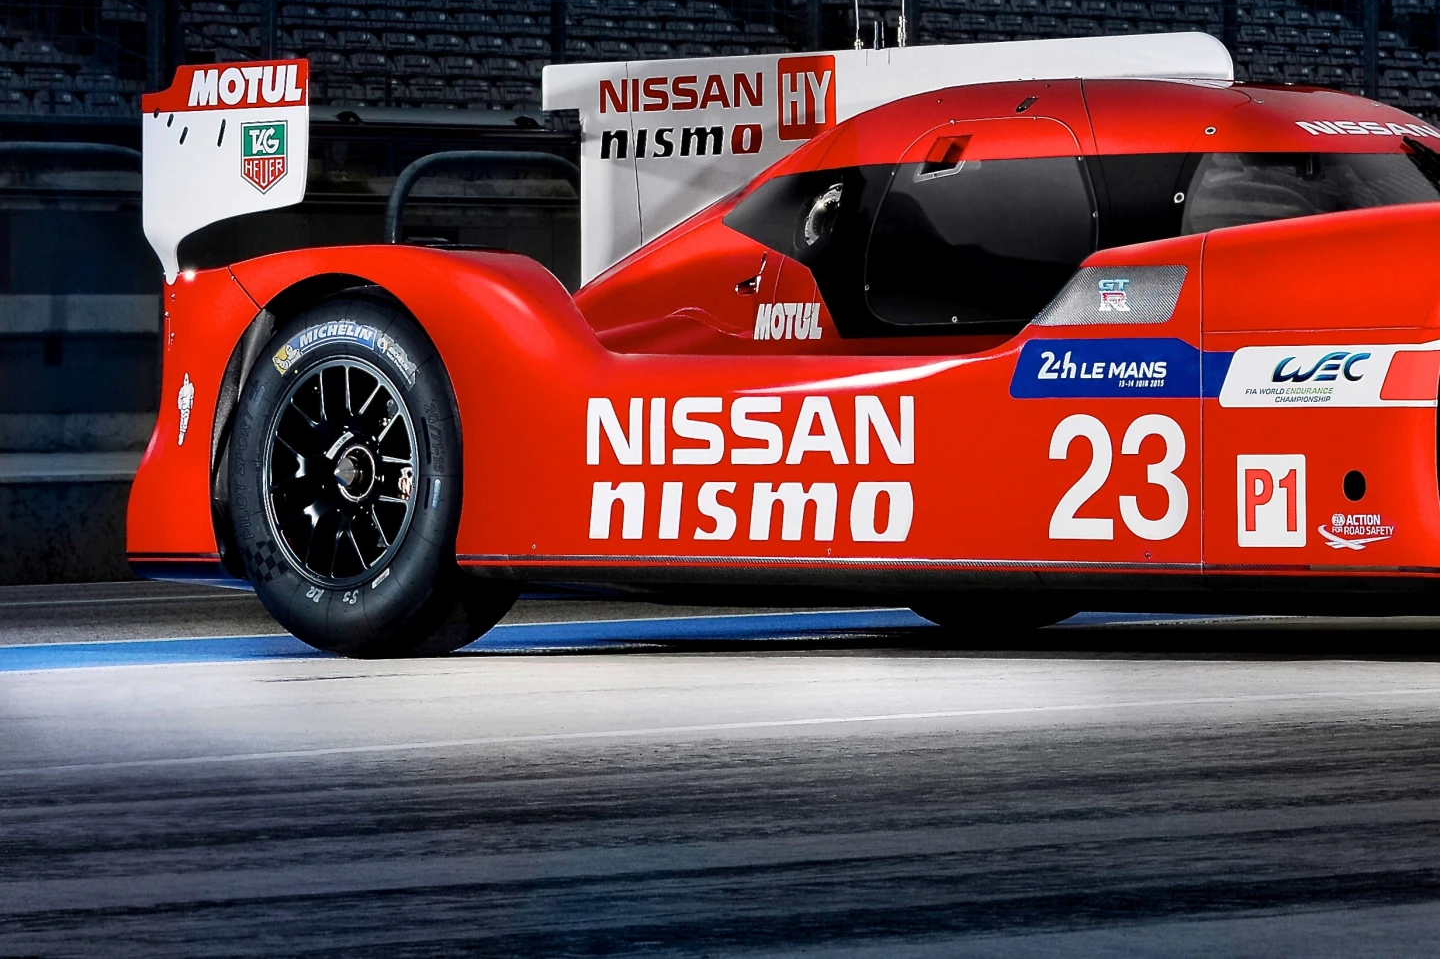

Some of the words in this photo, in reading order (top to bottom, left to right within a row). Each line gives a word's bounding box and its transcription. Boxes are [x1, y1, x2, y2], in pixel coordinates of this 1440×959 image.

[187, 64, 303, 107] MOTUL
[599, 71, 764, 114] NISSAN
[782, 70, 832, 126] HY
[249, 127, 280, 155] TAG
[600, 123, 763, 160] nismo
[244, 159, 284, 187] HEUER
[1098, 279, 1130, 291] GT
[1098, 291, 1130, 312] R
[299, 324, 374, 348] MICHELIN
[753, 302, 824, 340] MOTUL
[1080, 362, 1106, 379] LE
[1108, 361, 1167, 379] MANS
[1271, 351, 1372, 383] WEC
[1285, 387, 1334, 395] ENDURANCE
[586, 395, 915, 465] NISSAN
[1048, 413, 1189, 540] 23
[588, 481, 915, 542] nismo
[1244, 468, 1298, 533] P1
[1344, 526, 1365, 535] ROAD
[1366, 526, 1394, 535] SAFETY
[1346, 514, 1380, 526] ACTION
